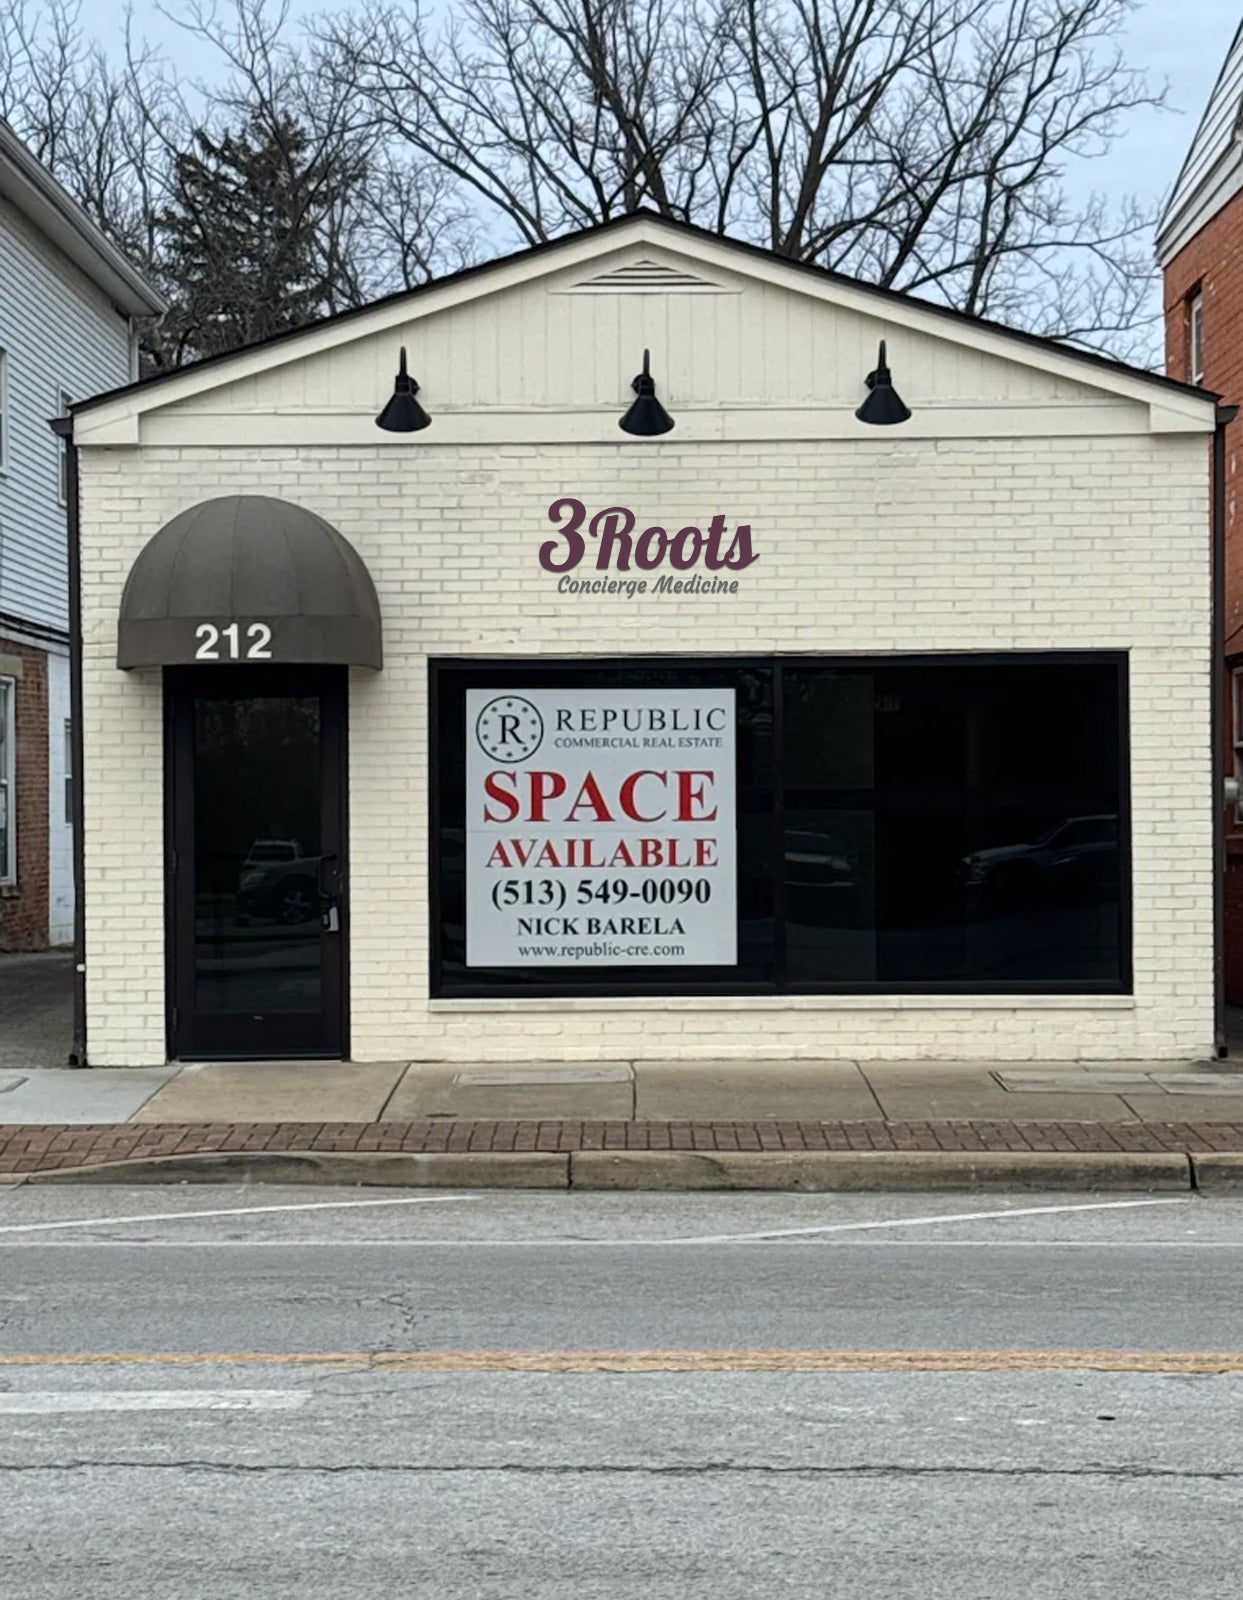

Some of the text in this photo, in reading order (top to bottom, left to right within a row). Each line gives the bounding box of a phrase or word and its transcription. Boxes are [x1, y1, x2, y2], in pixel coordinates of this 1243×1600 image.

[557, 574, 739, 599] Concierge Medicine
[195, 623, 273, 660] 212
[498, 715, 525, 746] R
[556, 708, 726, 732] REPUBLIC
[554, 737, 722, 748] COMMERCIAL REAL ESTATE
[484, 770, 718, 824] SPACE
[485, 838, 719, 868] AVAILABLE
[491, 878, 711, 912] (513) 549-0090
[517, 917, 685, 936] NICK BARELA
[518, 942, 685, 960] www.republic-cre.com
